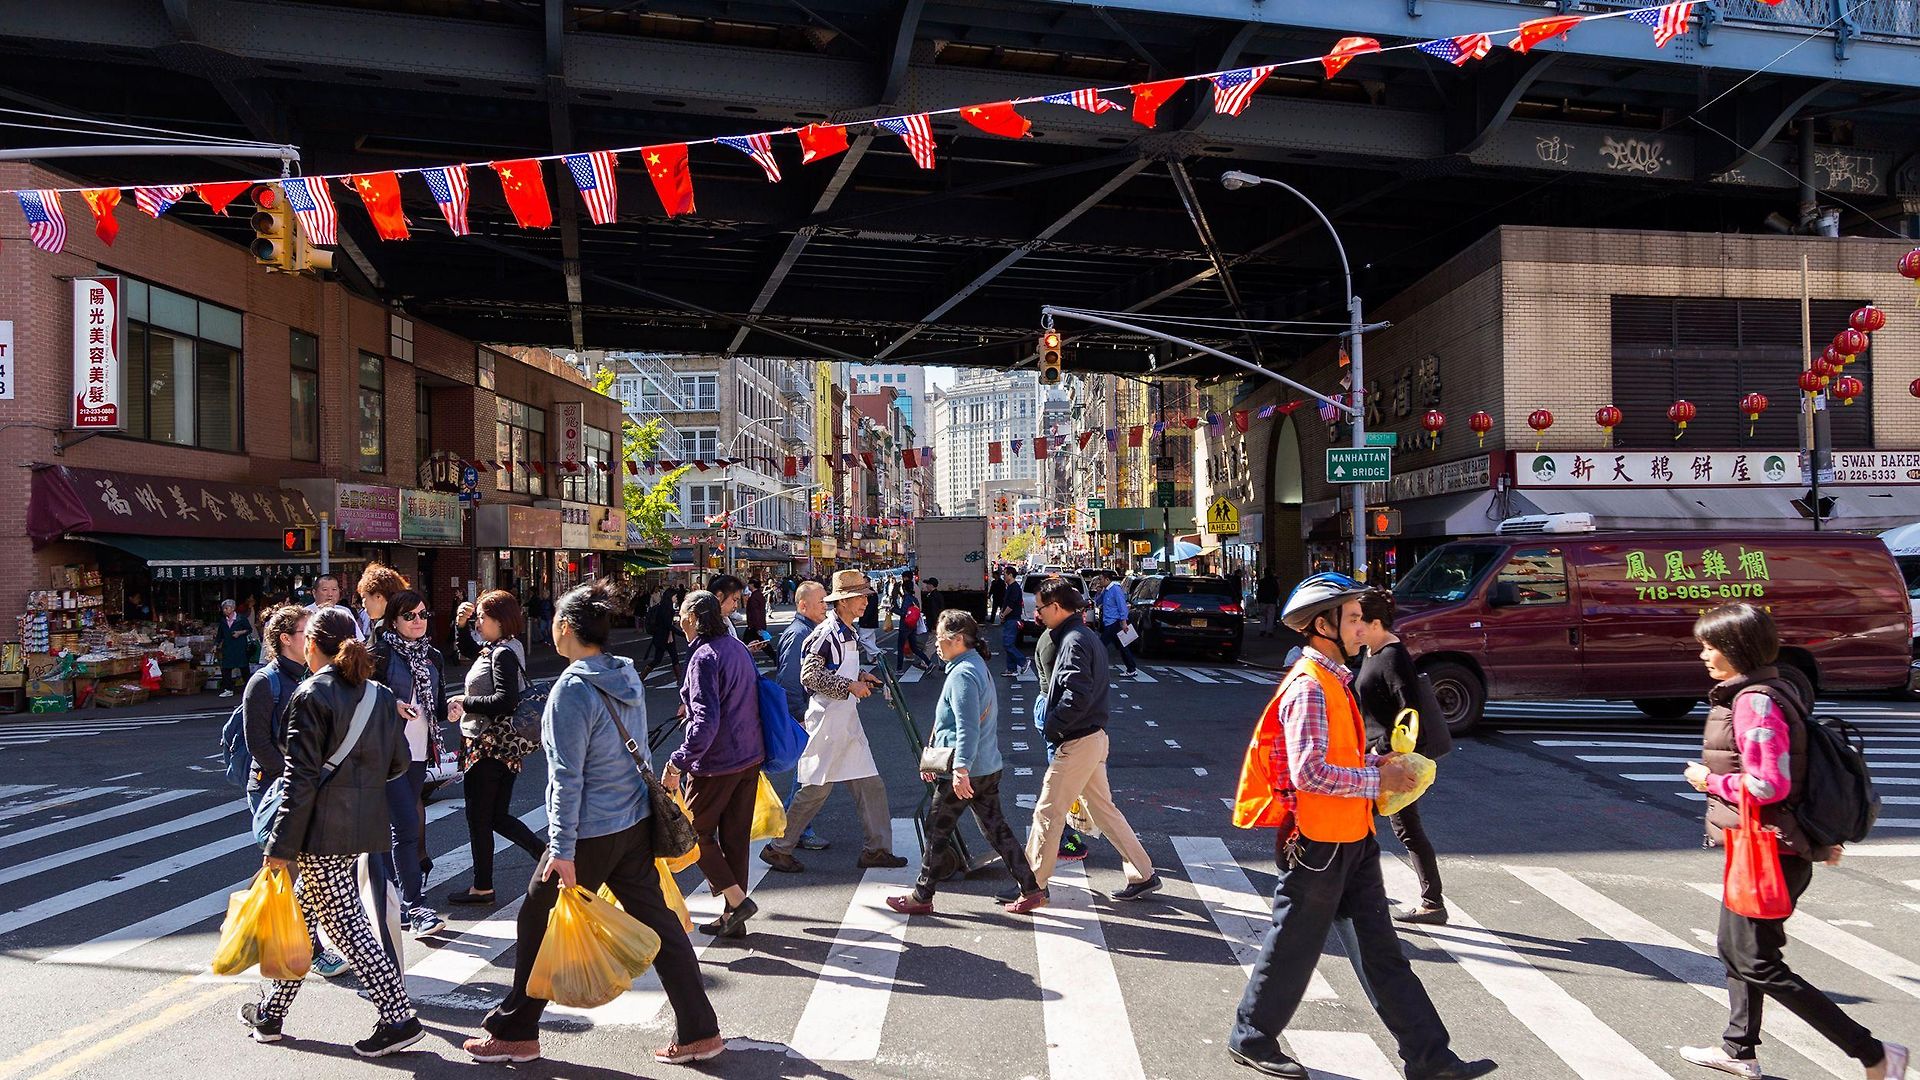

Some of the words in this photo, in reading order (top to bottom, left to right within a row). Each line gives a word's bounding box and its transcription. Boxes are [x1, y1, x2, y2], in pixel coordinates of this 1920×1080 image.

[89, 288, 105, 403] 陽光美容美髮
[1331, 453, 1387, 462] MANHATTAN
[1842, 455, 1876, 467] SWAN
[1352, 467, 1385, 476] BRIDGE
[1570, 455, 1751, 482] 新天鵝餅屋
[1850, 469, 1896, 480] 226-5333
[1210, 523, 1237, 532] AHEAD
[1625, 546, 1770, 582] 鳳凰雞欄
[1635, 583, 1765, 600] 718-965-6078
